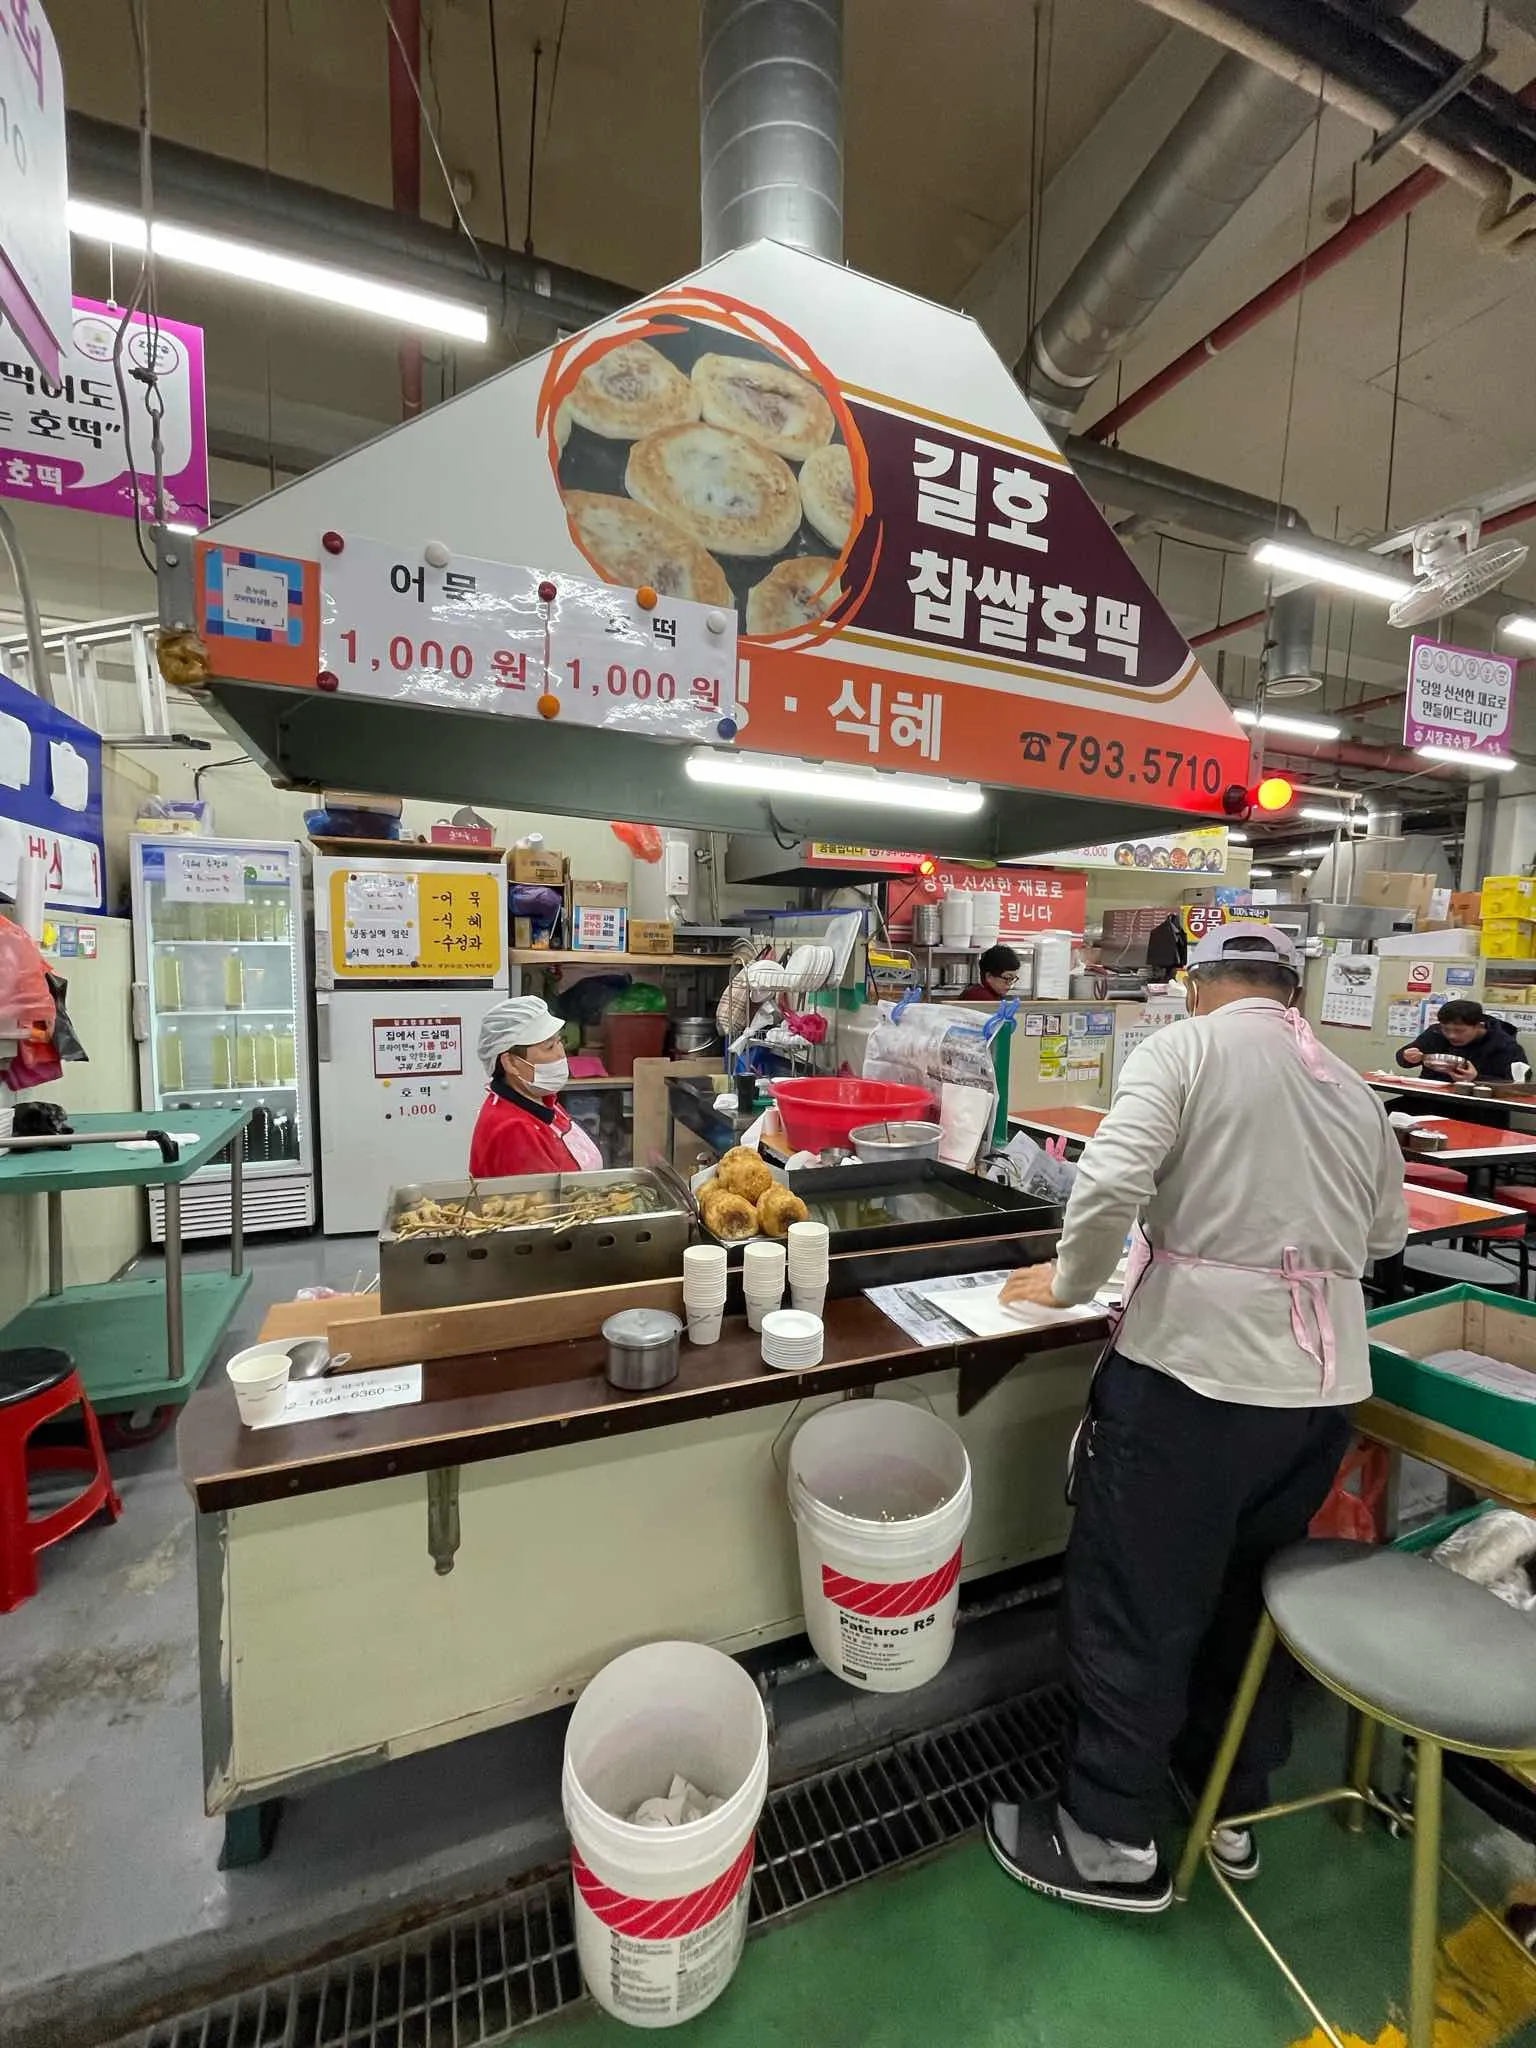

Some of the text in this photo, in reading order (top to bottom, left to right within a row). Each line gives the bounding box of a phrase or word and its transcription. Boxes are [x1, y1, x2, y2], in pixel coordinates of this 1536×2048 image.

[0, 457, 62, 495] 호떡
[912, 437, 1050, 553] 길호
[906, 549, 1142, 677] 찹쌀호떡
[339, 629, 527, 691] 1,000 원
[566, 659, 676, 703] 1,000
[690, 677, 720, 713] 원
[827, 680, 943, 762] 식혜
[1444, 684, 1475, 705] 신선한
[1477, 691, 1507, 710] 재료로
[1056, 731, 1222, 794] 793.5710
[924, 874, 1063, 899] 당일 신선한 재료로
[385, 1029, 450, 1041] 집에서 드실때
[840, 1614, 936, 1637] Patchroc RS
